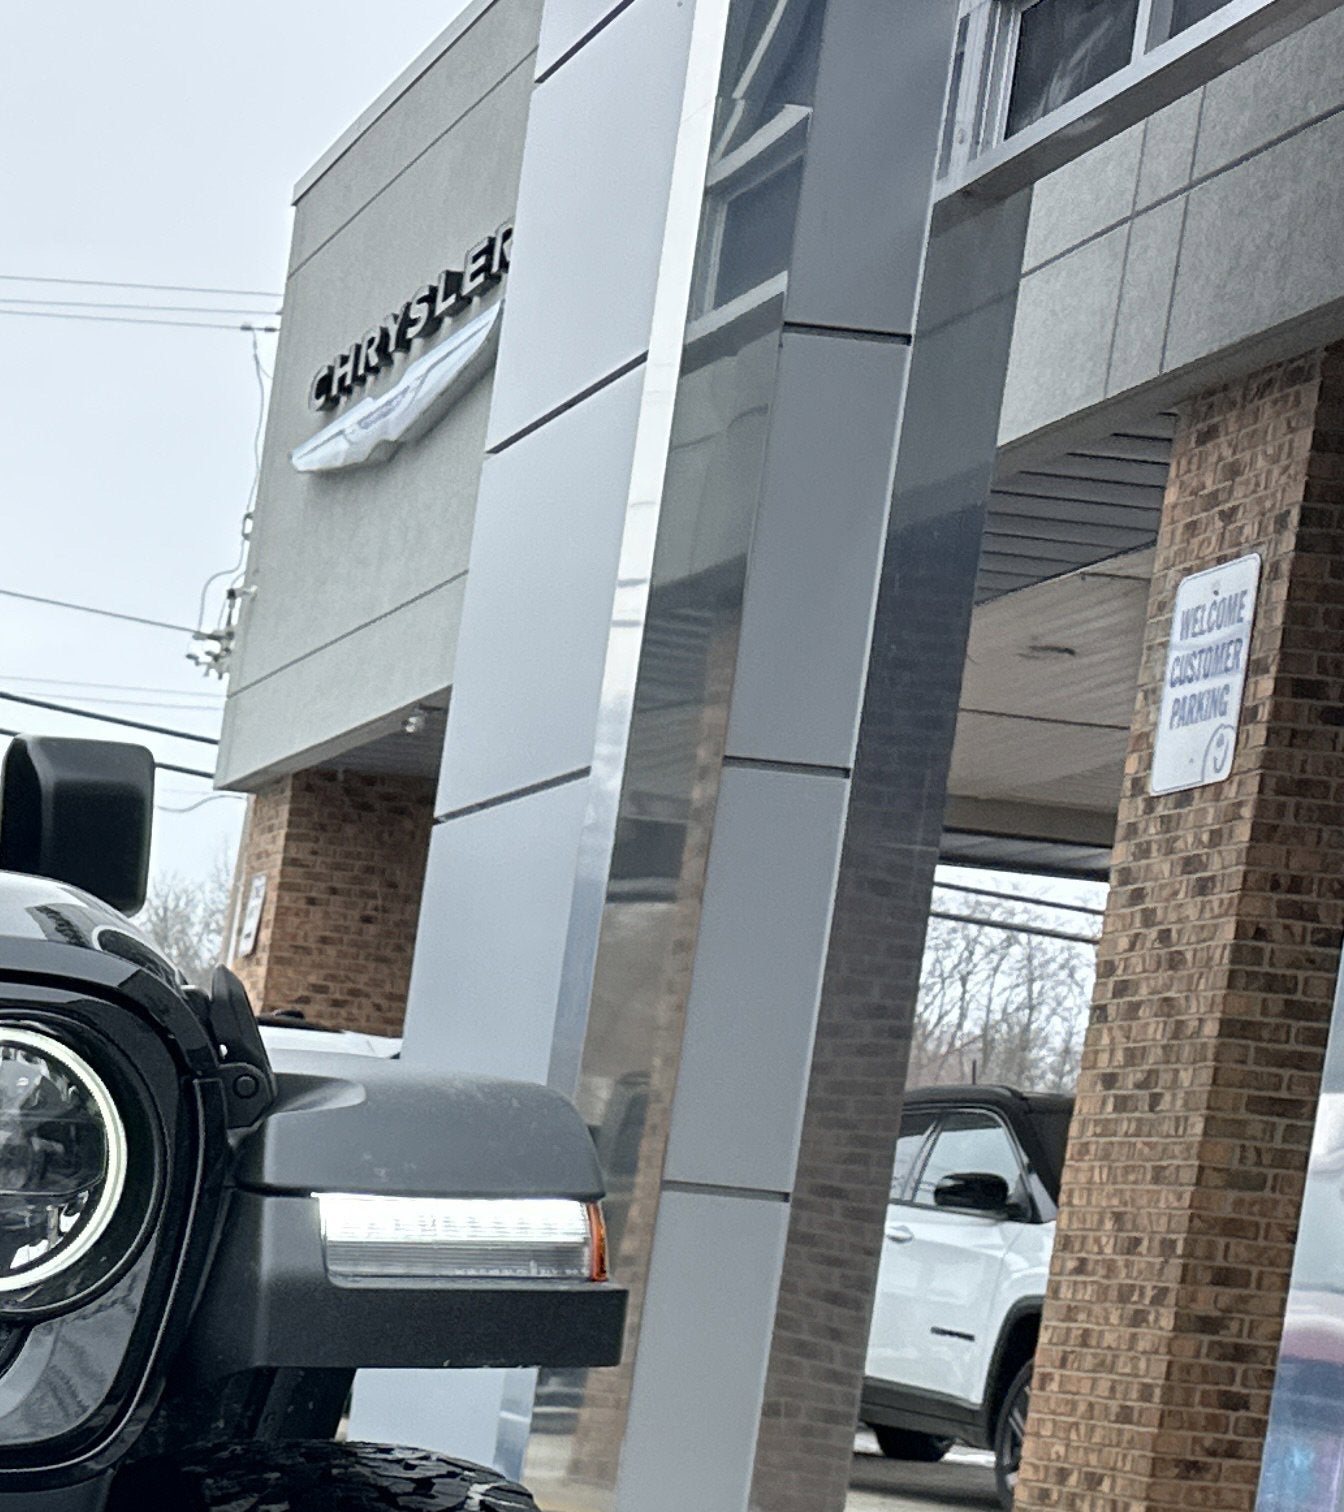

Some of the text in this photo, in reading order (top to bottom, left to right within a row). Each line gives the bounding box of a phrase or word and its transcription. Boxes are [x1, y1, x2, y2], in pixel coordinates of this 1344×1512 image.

[310, 220, 513, 411] CHRYSLER
[1181, 591, 1247, 640] WELCOME
[1170, 639, 1243, 688] CUSTOMER
[1169, 685, 1230, 730] PARKING
